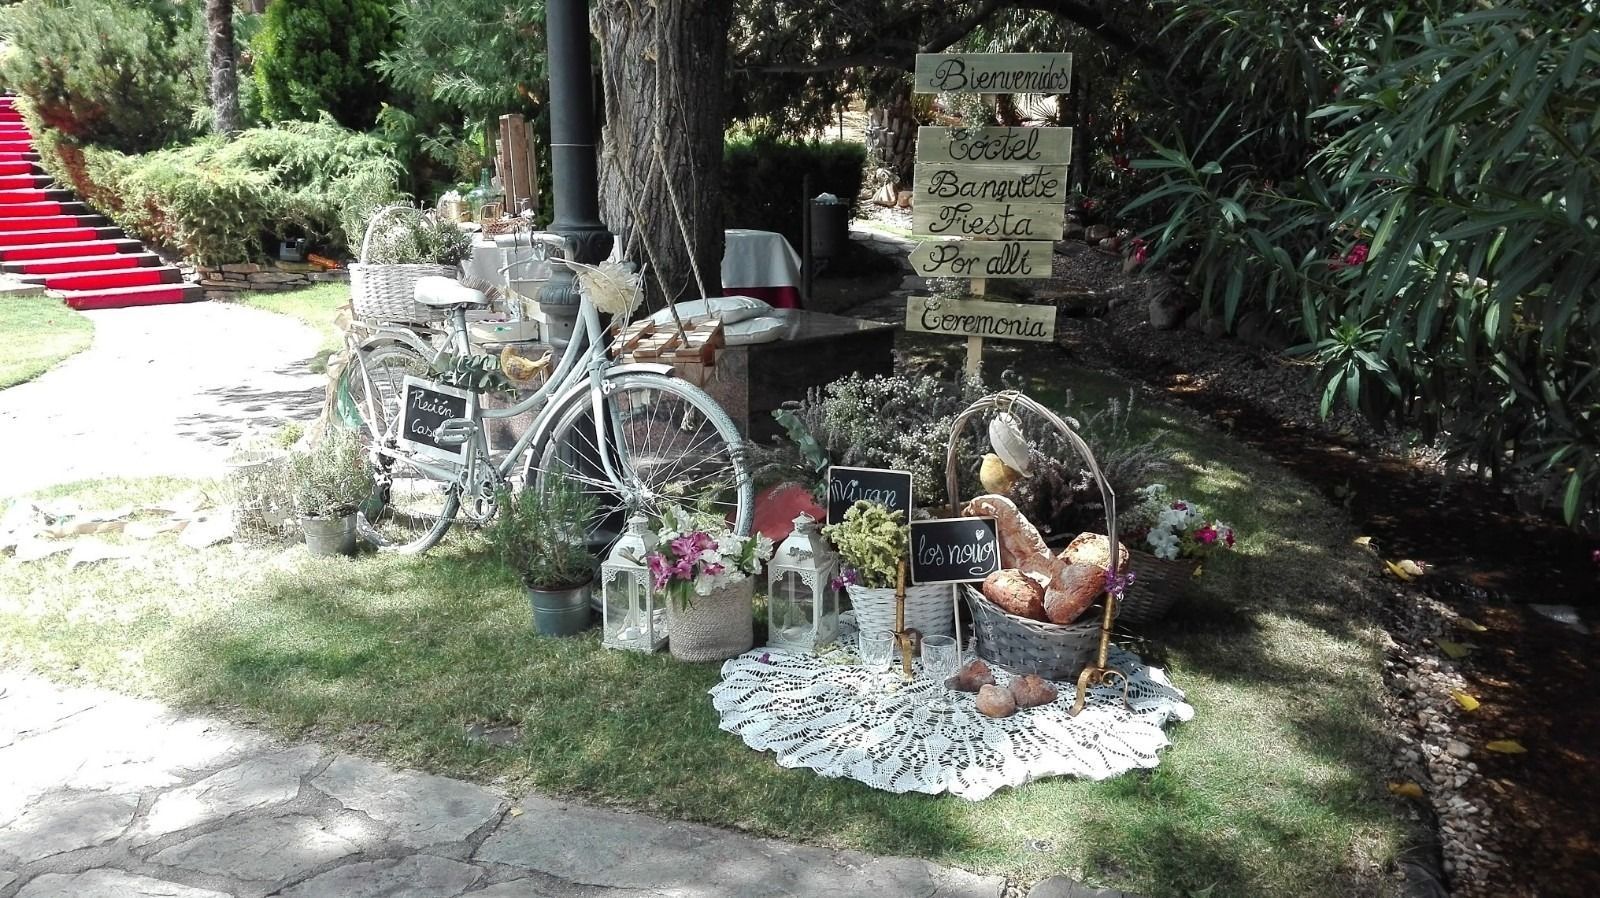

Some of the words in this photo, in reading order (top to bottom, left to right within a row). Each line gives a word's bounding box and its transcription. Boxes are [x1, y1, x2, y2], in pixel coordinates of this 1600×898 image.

[930, 56, 1068, 91] Bienvenidos
[928, 165, 1058, 203] Banquete
[929, 203, 1033, 236] Fiesta
[923, 245, 980, 275] Por
[921, 299, 1047, 338] Ceremonia
[410, 389, 455, 418] Recién
[918, 534, 945, 566] los
